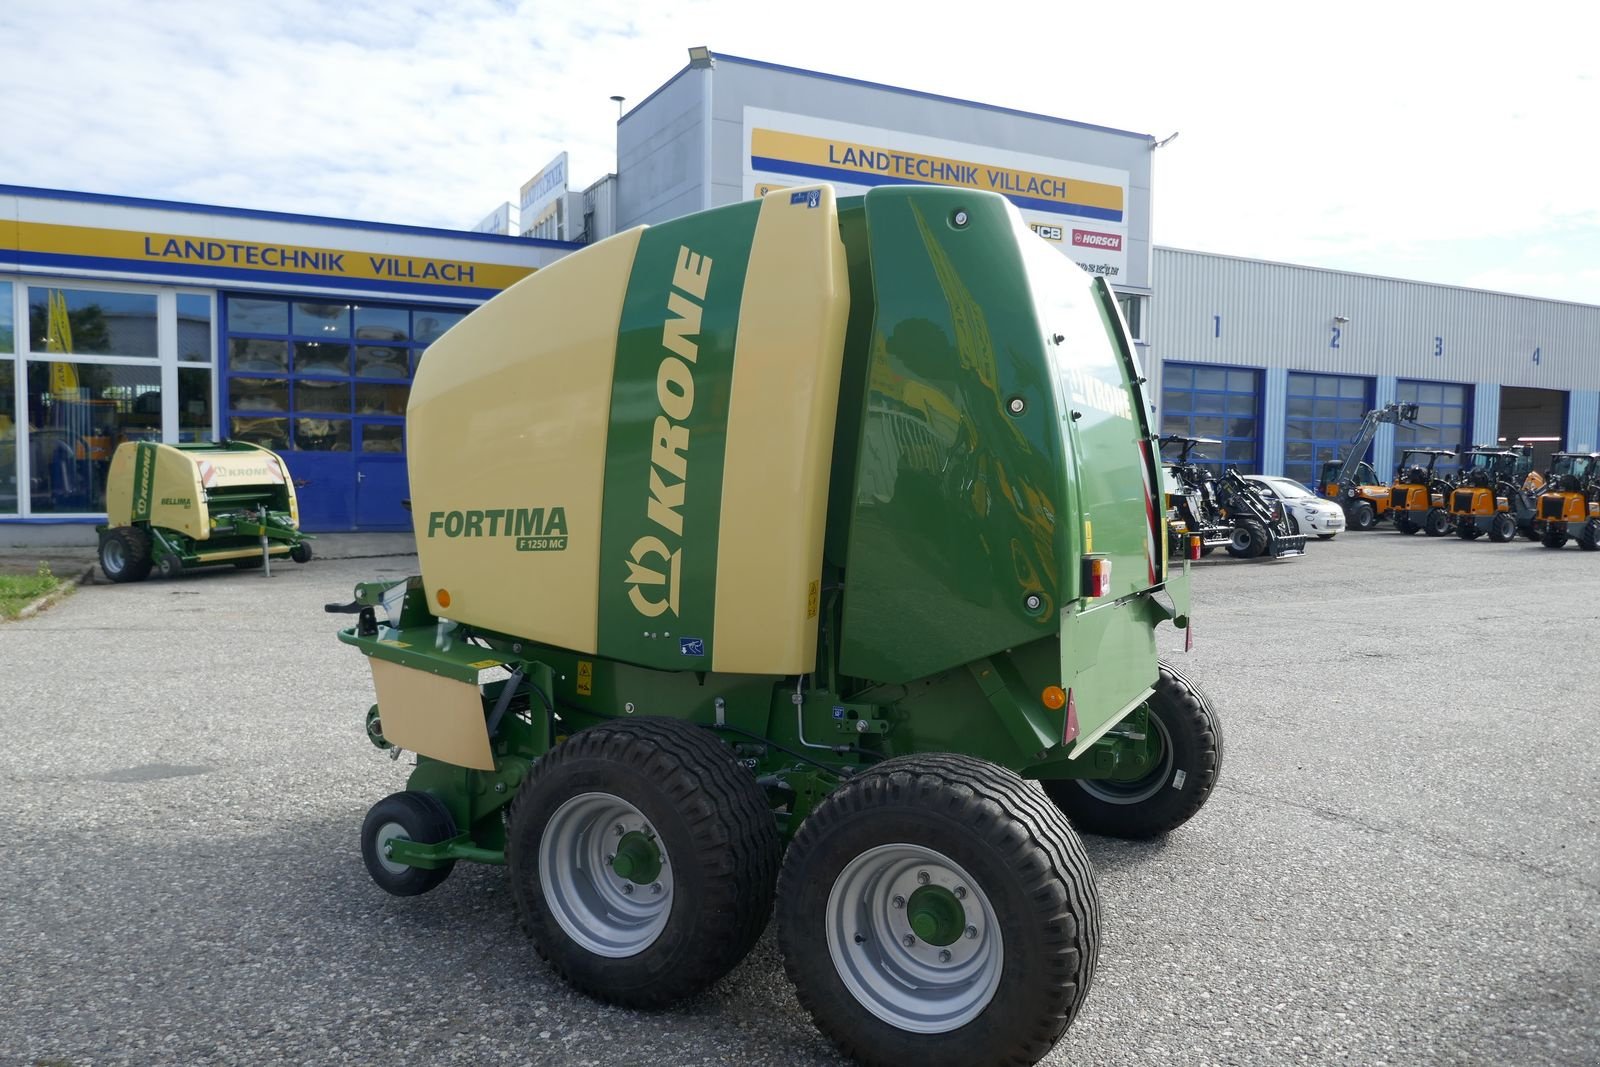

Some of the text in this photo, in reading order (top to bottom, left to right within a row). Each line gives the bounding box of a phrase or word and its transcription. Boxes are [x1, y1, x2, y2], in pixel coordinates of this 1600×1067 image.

[829, 144, 1067, 198] LANDTECHNIK VILLACH
[1082, 234, 1120, 248] HORSCH
[144, 236, 475, 283] LANDTECHNIK VILLACH
[1213, 315, 1221, 338] 1
[1329, 327, 1341, 349] 2
[1434, 336, 1444, 357] 3
[1532, 346, 1541, 366] 4
[647, 244, 713, 537] KRONE
[141, 447, 152, 501] KRONE
[228, 466, 269, 478] KRONE
[160, 497, 191, 506] BELLIMA
[427, 506, 569, 538] FORTIMA
[520, 539, 564, 549] F 1250 MC
